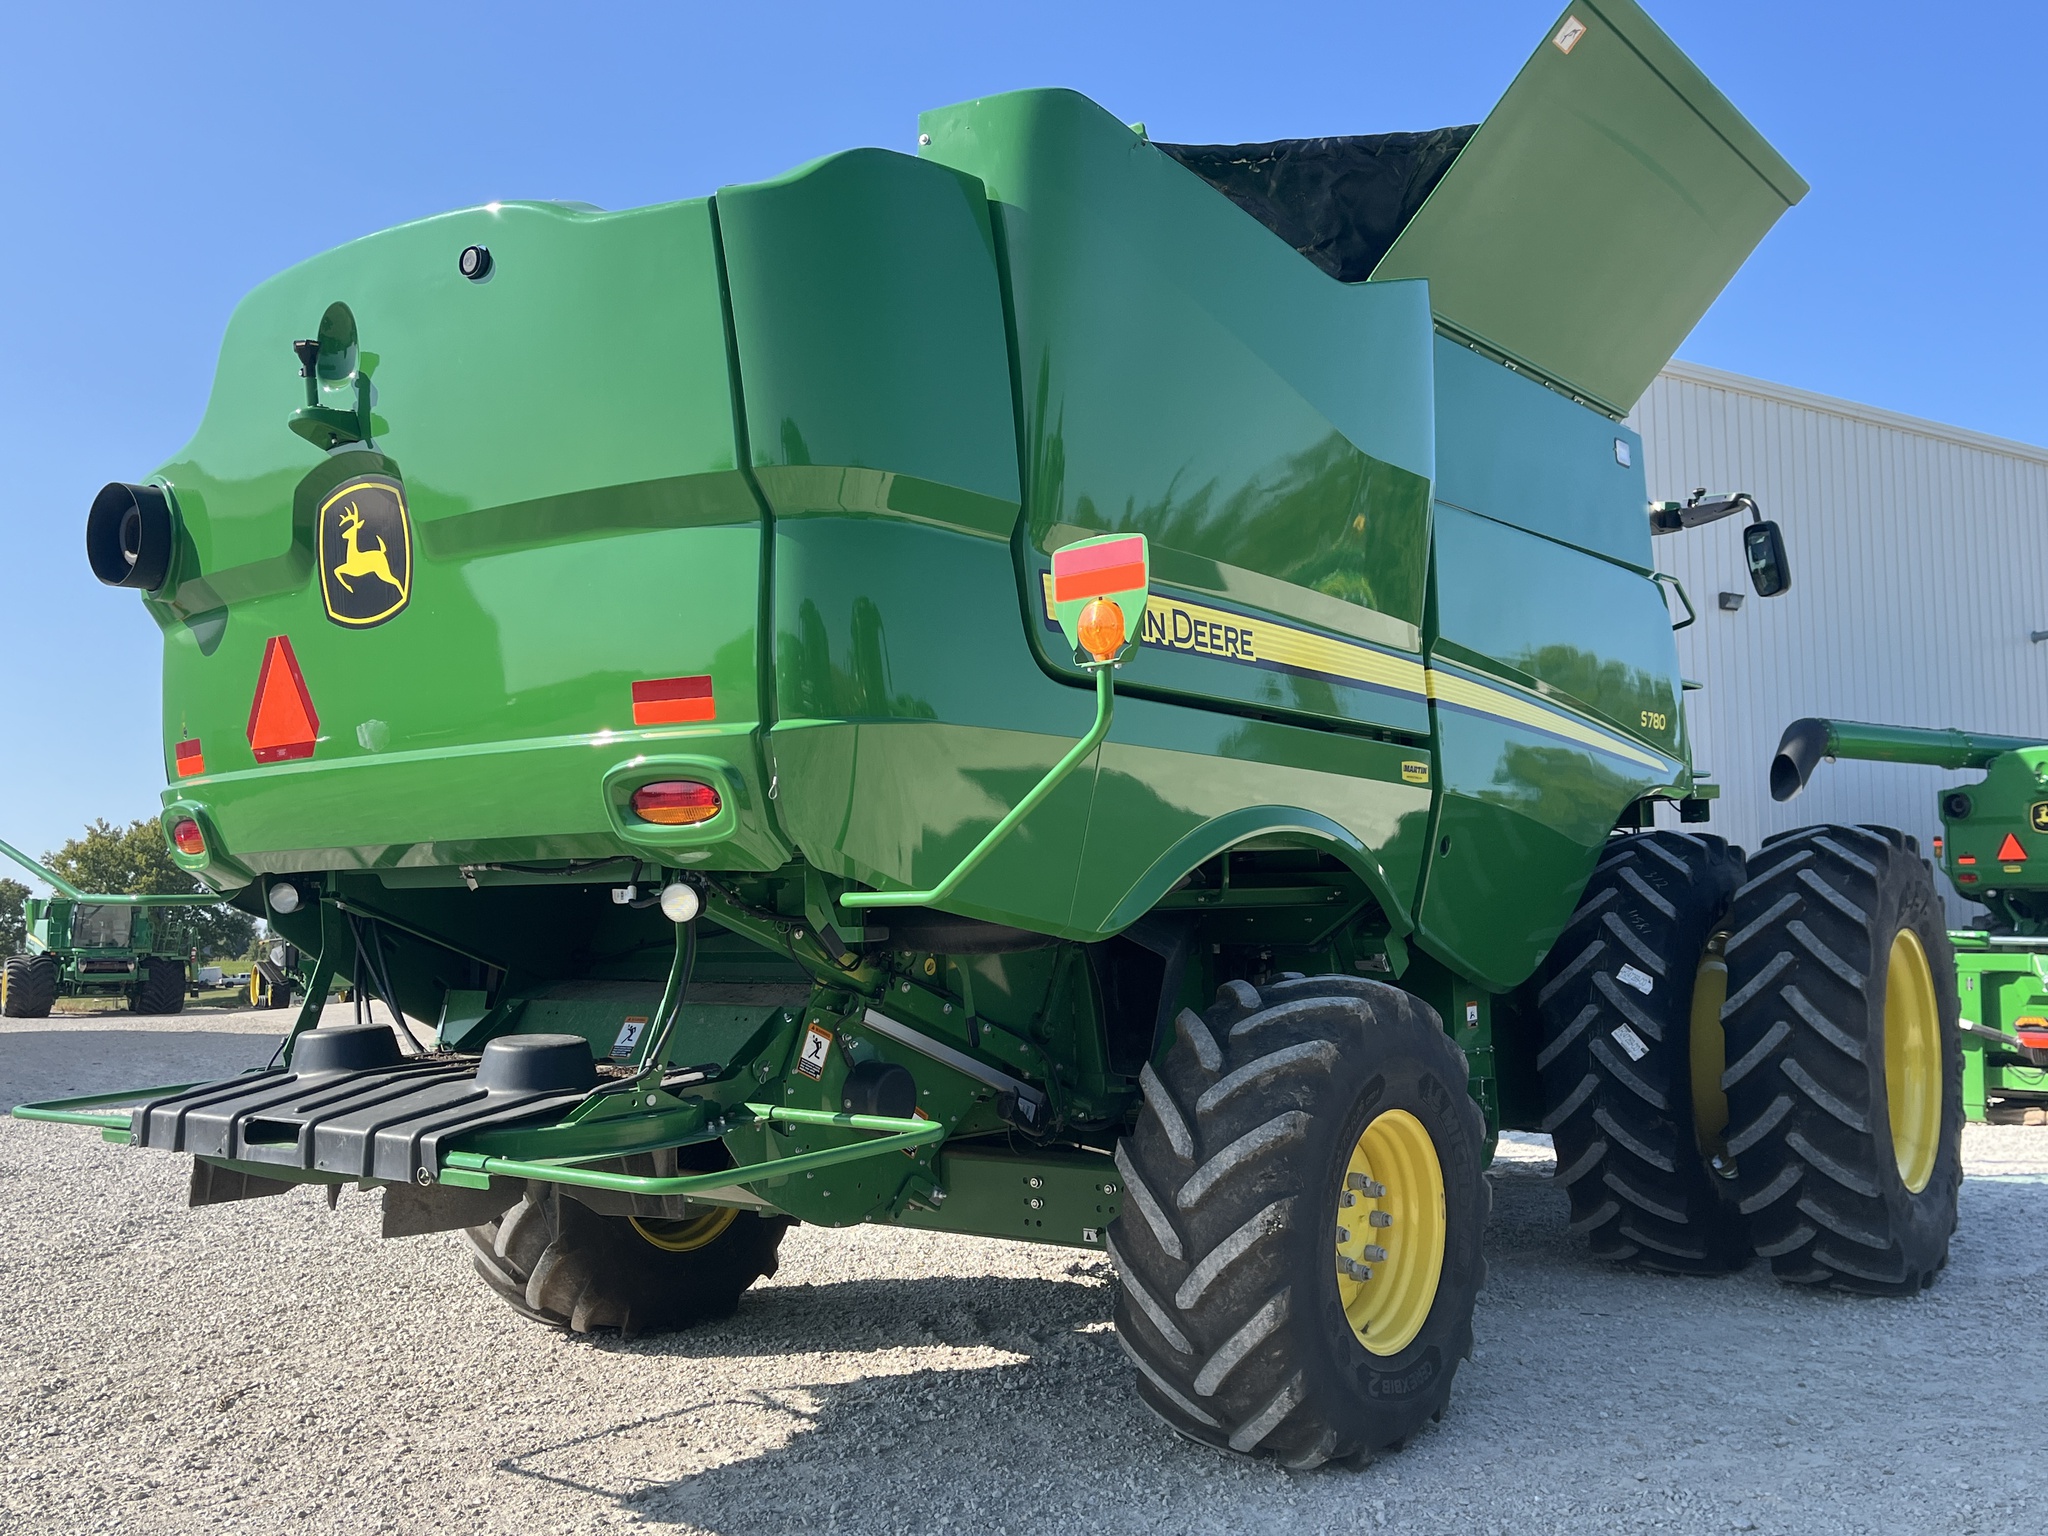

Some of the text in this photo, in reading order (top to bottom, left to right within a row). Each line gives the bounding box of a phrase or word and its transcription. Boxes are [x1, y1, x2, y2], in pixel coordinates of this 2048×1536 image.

[1172, 609, 1255, 658] DEERE
[1641, 711, 1666, 730] S780
[1404, 764, 1427, 774] MARTIN
[1368, 1371, 1381, 1398] 2
